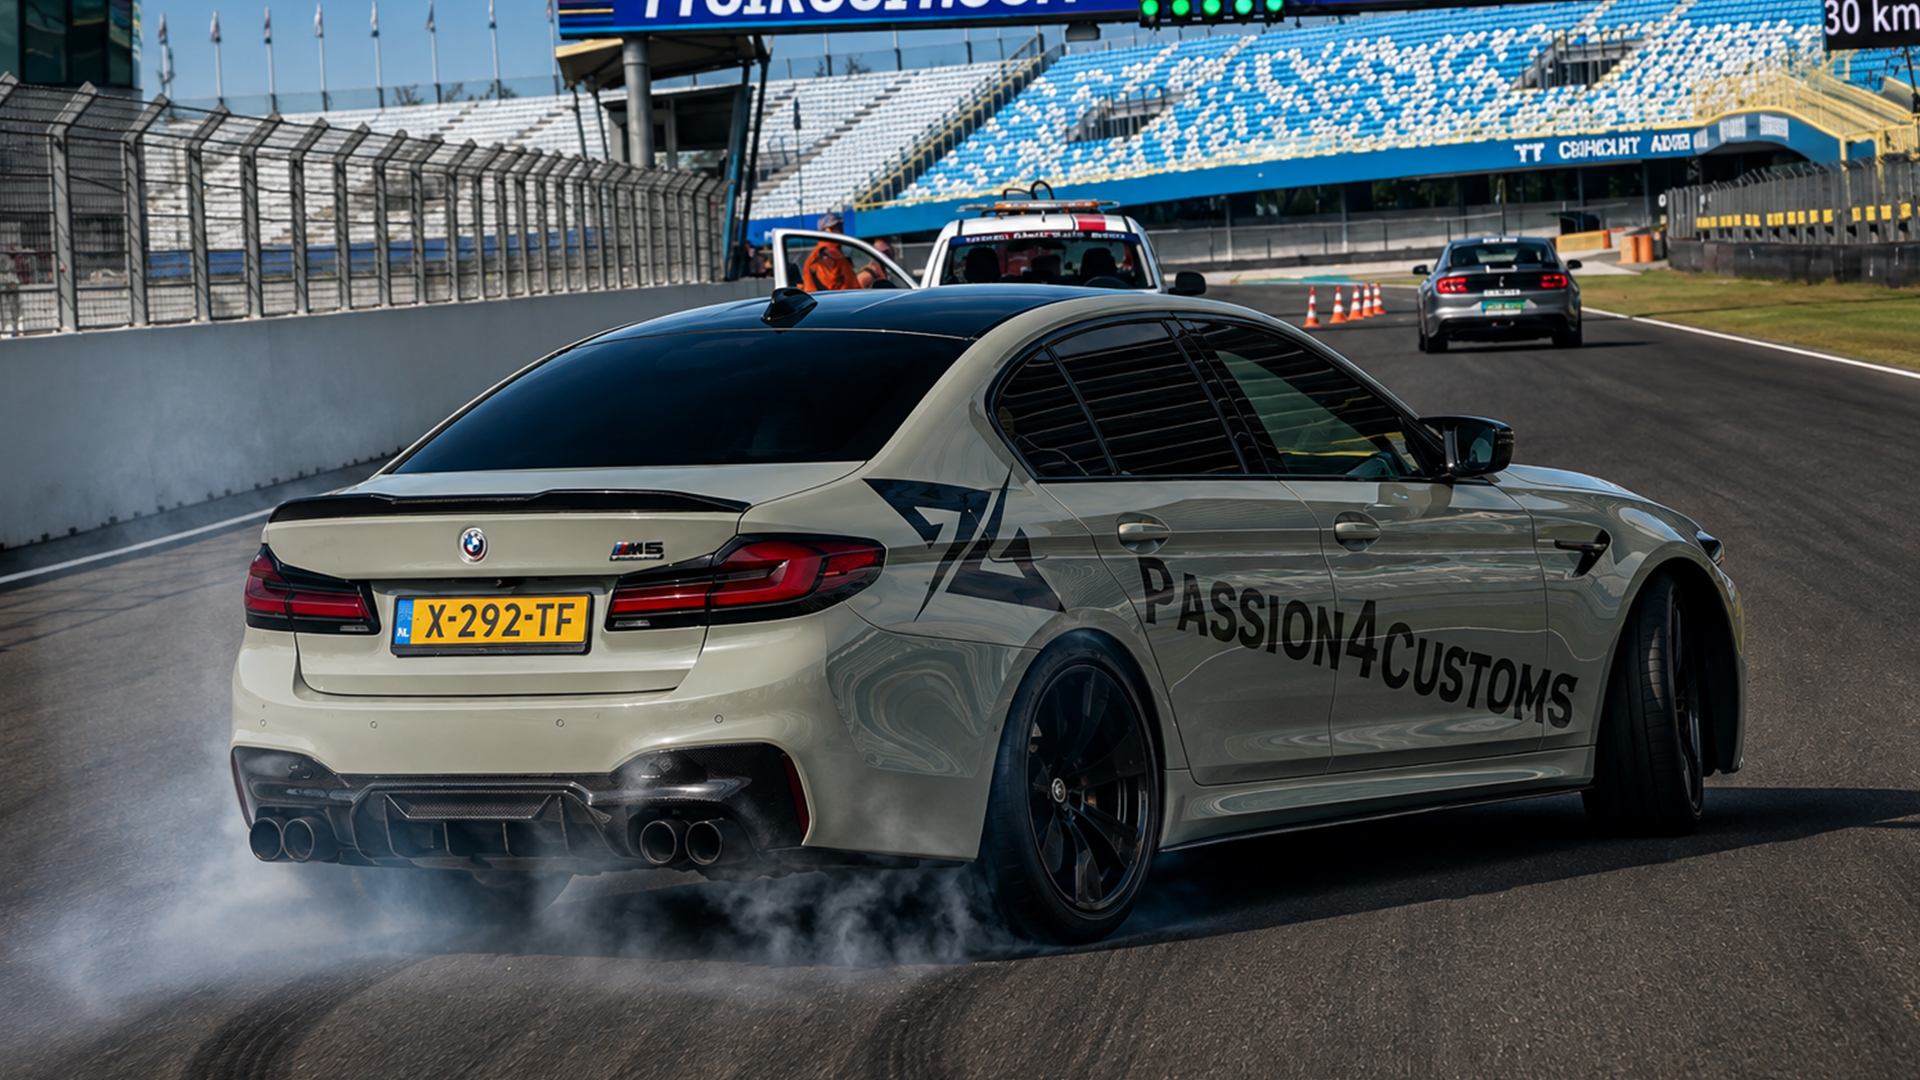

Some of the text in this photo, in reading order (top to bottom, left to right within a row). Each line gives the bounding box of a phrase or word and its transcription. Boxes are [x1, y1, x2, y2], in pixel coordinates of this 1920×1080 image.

[1825, 0, 1861, 35] 30
[622, 541, 664, 555] M5
[424, 602, 576, 638] X-292-TF
[396, 627, 410, 638] NL
